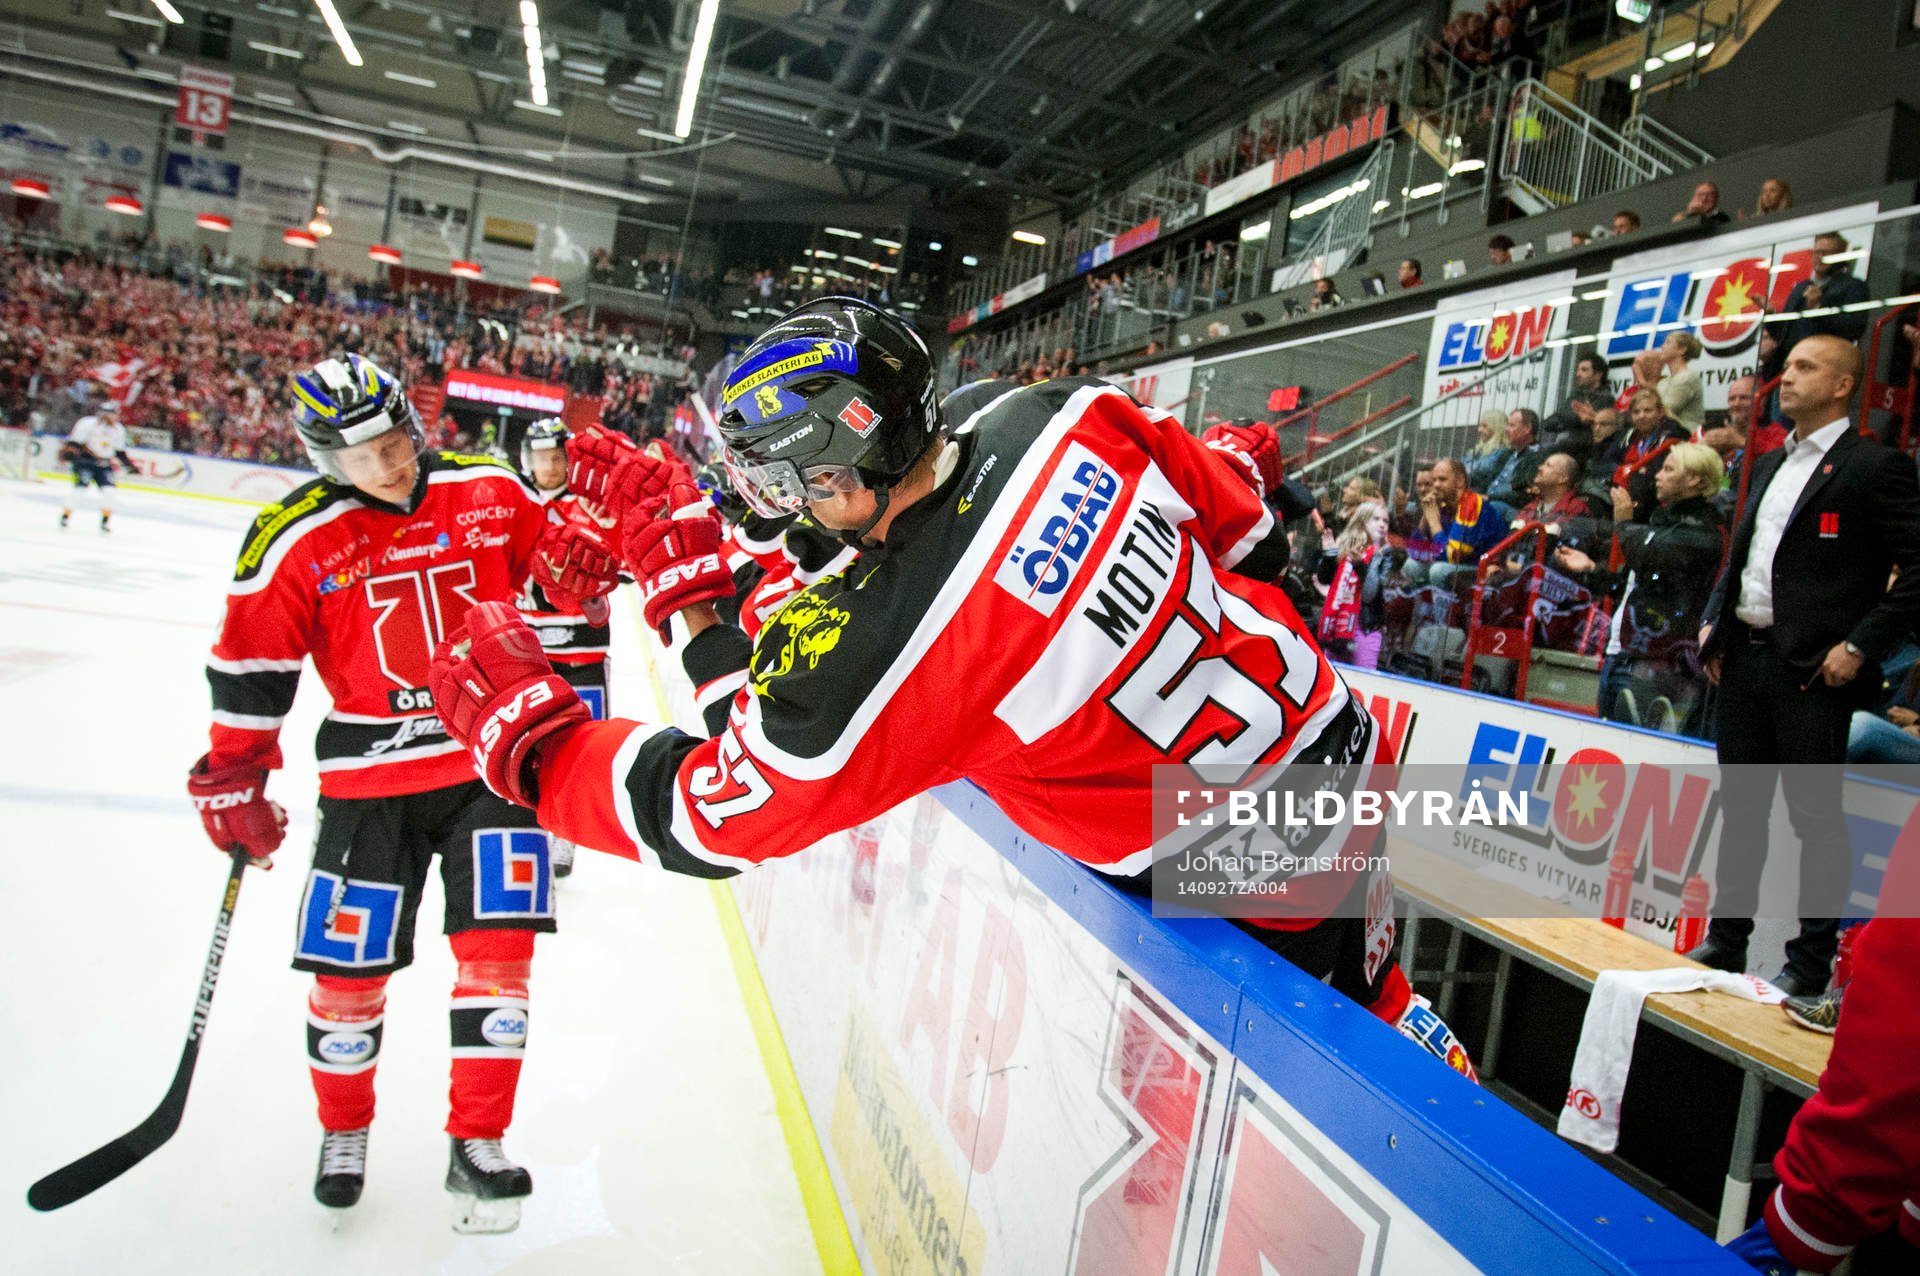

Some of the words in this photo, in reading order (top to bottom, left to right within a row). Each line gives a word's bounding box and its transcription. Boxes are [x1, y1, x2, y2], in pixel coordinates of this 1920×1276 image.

[187, 91, 222, 125] 13
[1438, 304, 1553, 367] ELON
[758, 358, 801, 381] SLAKTERI
[804, 355, 819, 364] AB
[1883, 388, 1894, 409] 5
[768, 423, 814, 452] EASTON
[966, 453, 998, 502] EASTON
[1010, 461, 1118, 595] ÖBAB
[646, 553, 720, 598] EAST
[1083, 500, 1176, 649] MOTIN
[1106, 534, 1318, 786] 57
[1492, 631, 1507, 654] 2
[473, 680, 554, 776] EAST
[194, 787, 254, 810] TON
[689, 728, 775, 830] 57
[1459, 722, 1711, 875] ELON
[1453, 830, 1528, 872] SVERIGES
